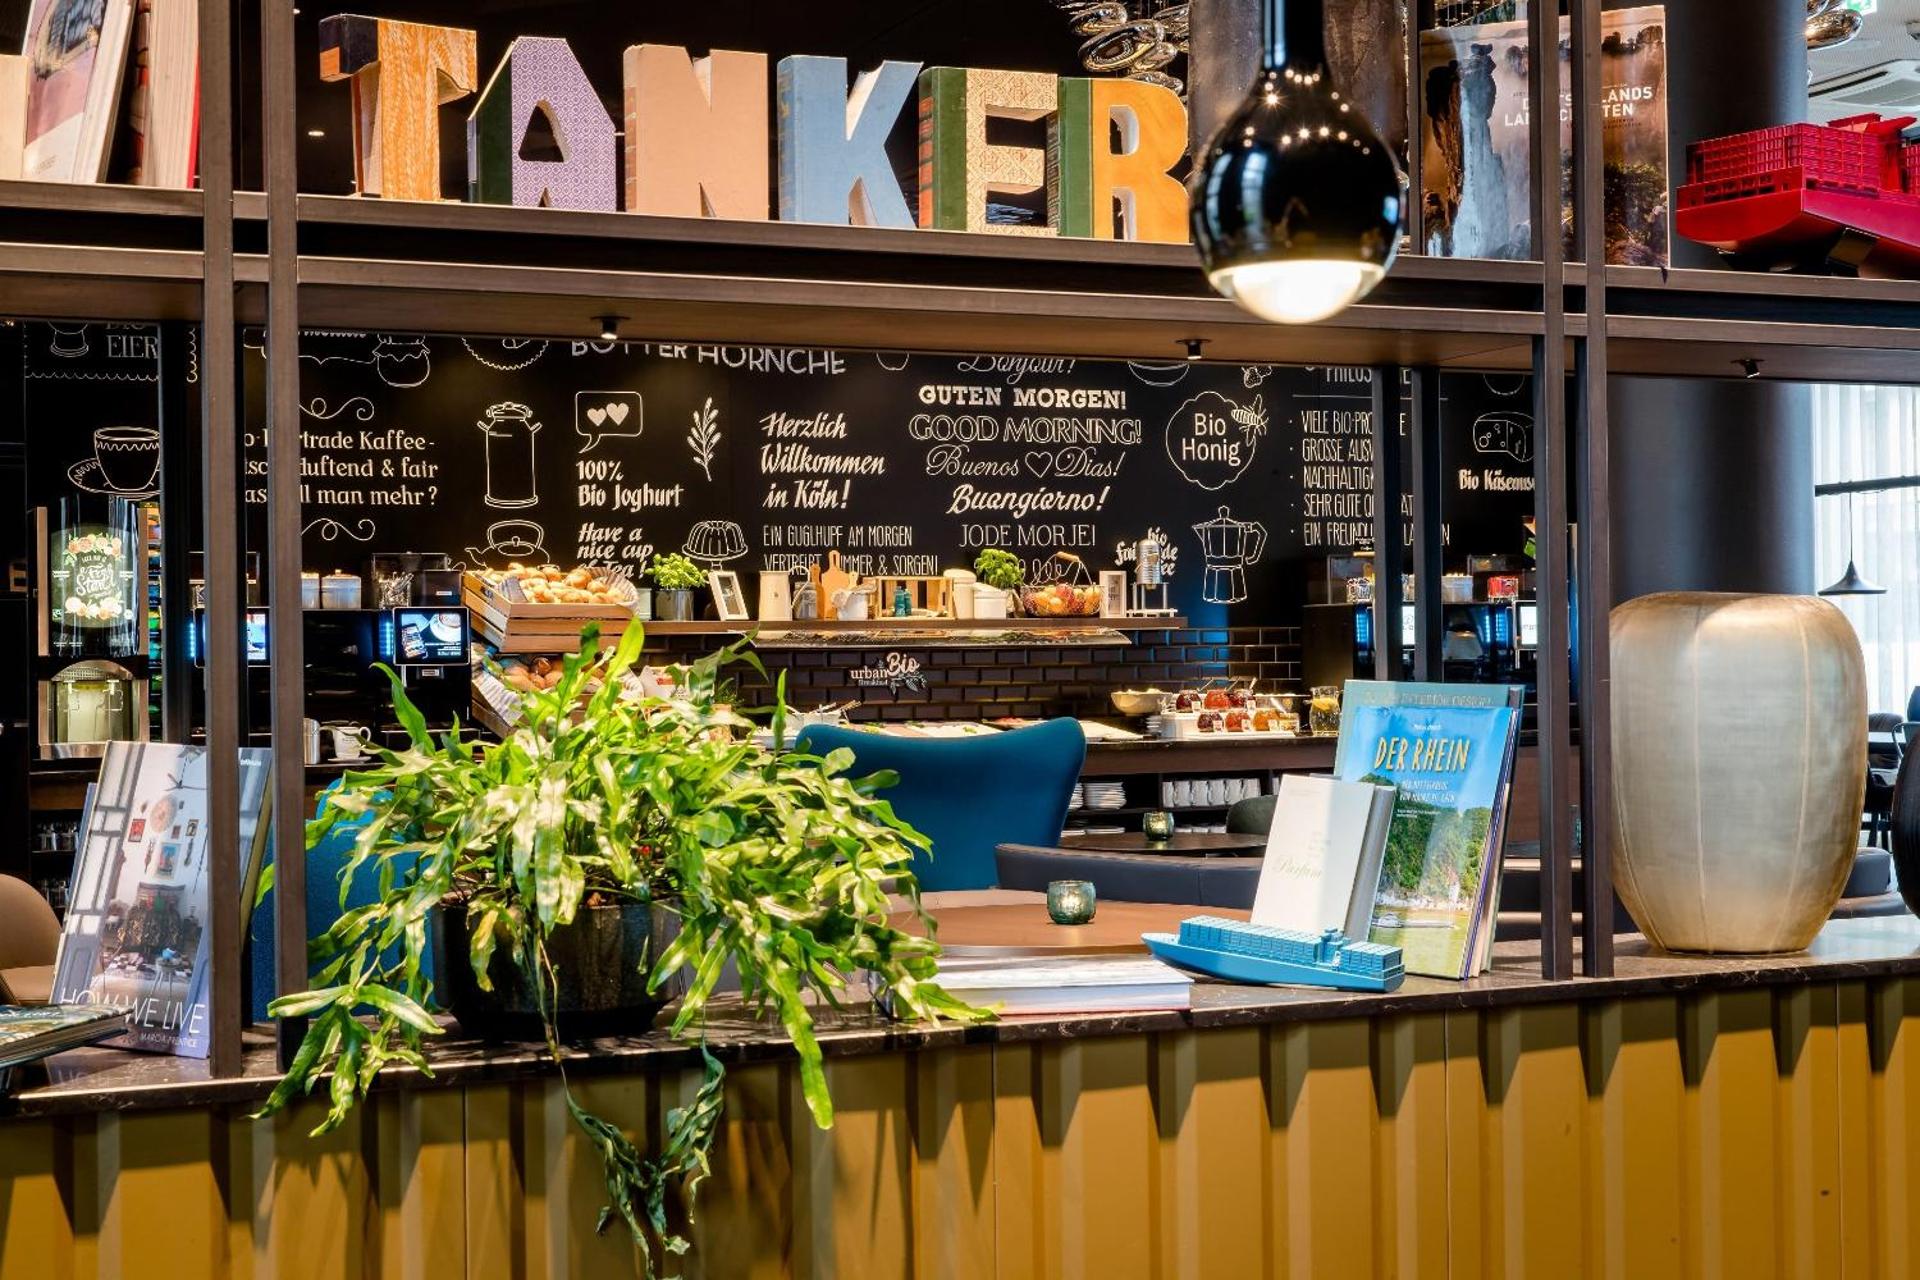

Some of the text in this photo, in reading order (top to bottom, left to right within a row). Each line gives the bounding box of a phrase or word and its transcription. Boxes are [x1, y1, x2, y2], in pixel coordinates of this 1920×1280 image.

[320, 12, 1190, 244] TANKER
[106, 334, 158, 359] EIER
[918, 384, 1127, 410] GUTEN MORGEN!
[760, 411, 847, 439] Herzlich
[908, 414, 1142, 445] GOOD MORNING!
[1194, 412, 1226, 436] Bio
[1301, 410, 1329, 434] VIELE
[760, 442, 885, 475] Willkommen
[926, 443, 1126, 477] Buenos Dias!
[1182, 438, 1241, 466] Honig
[1302, 438, 1344, 462] GROSSE
[381, 458, 395, 477] &
[402, 457, 439, 478] fair
[575, 460, 624, 482] 100%
[1458, 469, 1480, 490] Bio
[316, 488, 364, 505] man
[578, 482, 685, 513] Bio Joghurt
[762, 483, 789, 508] in
[1303, 493, 1333, 518] SEHR
[1334, 493, 1362, 518] GUTE
[578, 521, 642, 543] Have a
[763, 525, 913, 547] EIN GUGLHUPF AM MORGEN
[959, 524, 1012, 547] JODE
[1303, 522, 1322, 546] EIN
[577, 541, 654, 563] nice cup
[878, 556, 888, 576] &
[850, 652, 920, 679] urban Bio
[1372, 736, 1471, 773] DER RHEIN
[162, 1000, 206, 1034] LIVE
